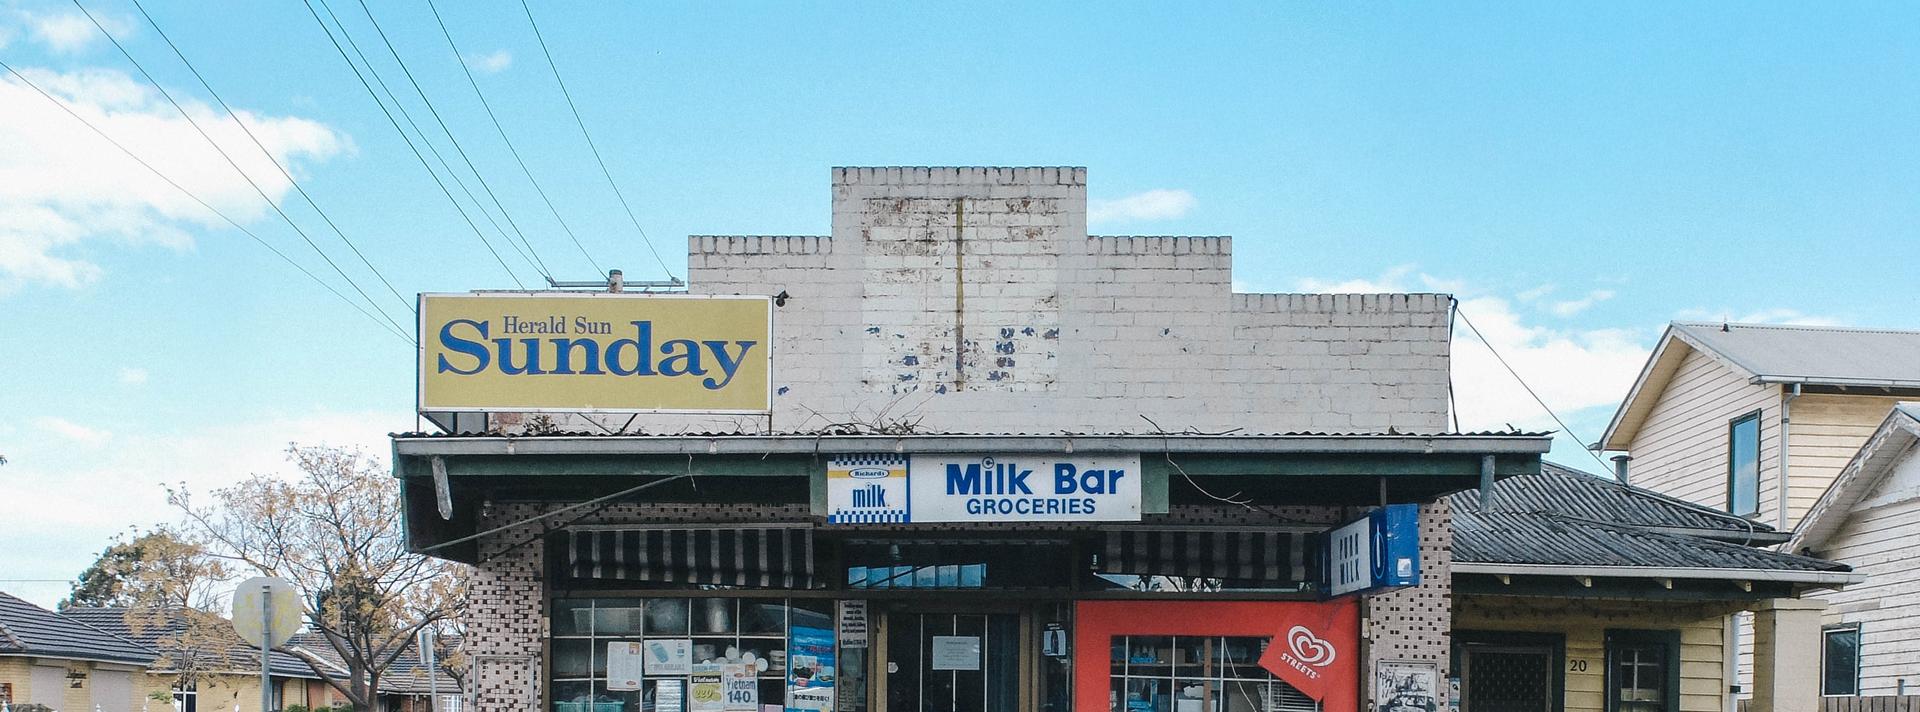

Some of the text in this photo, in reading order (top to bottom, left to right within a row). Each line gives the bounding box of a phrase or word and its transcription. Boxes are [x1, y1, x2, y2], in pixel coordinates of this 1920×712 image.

[503, 316, 612, 335] Herald Sun
[438, 319, 757, 390] Sunday
[946, 456, 1124, 495] Milk Bar
[853, 483, 886, 508] milk
[966, 498, 1096, 515] GROCERIES
[1340, 558, 1360, 585] MILK
[1281, 653, 1317, 679] STREETS
[1570, 659, 1587, 672] 20
[726, 677, 756, 690] Vietnam
[727, 691, 751, 703] 140
